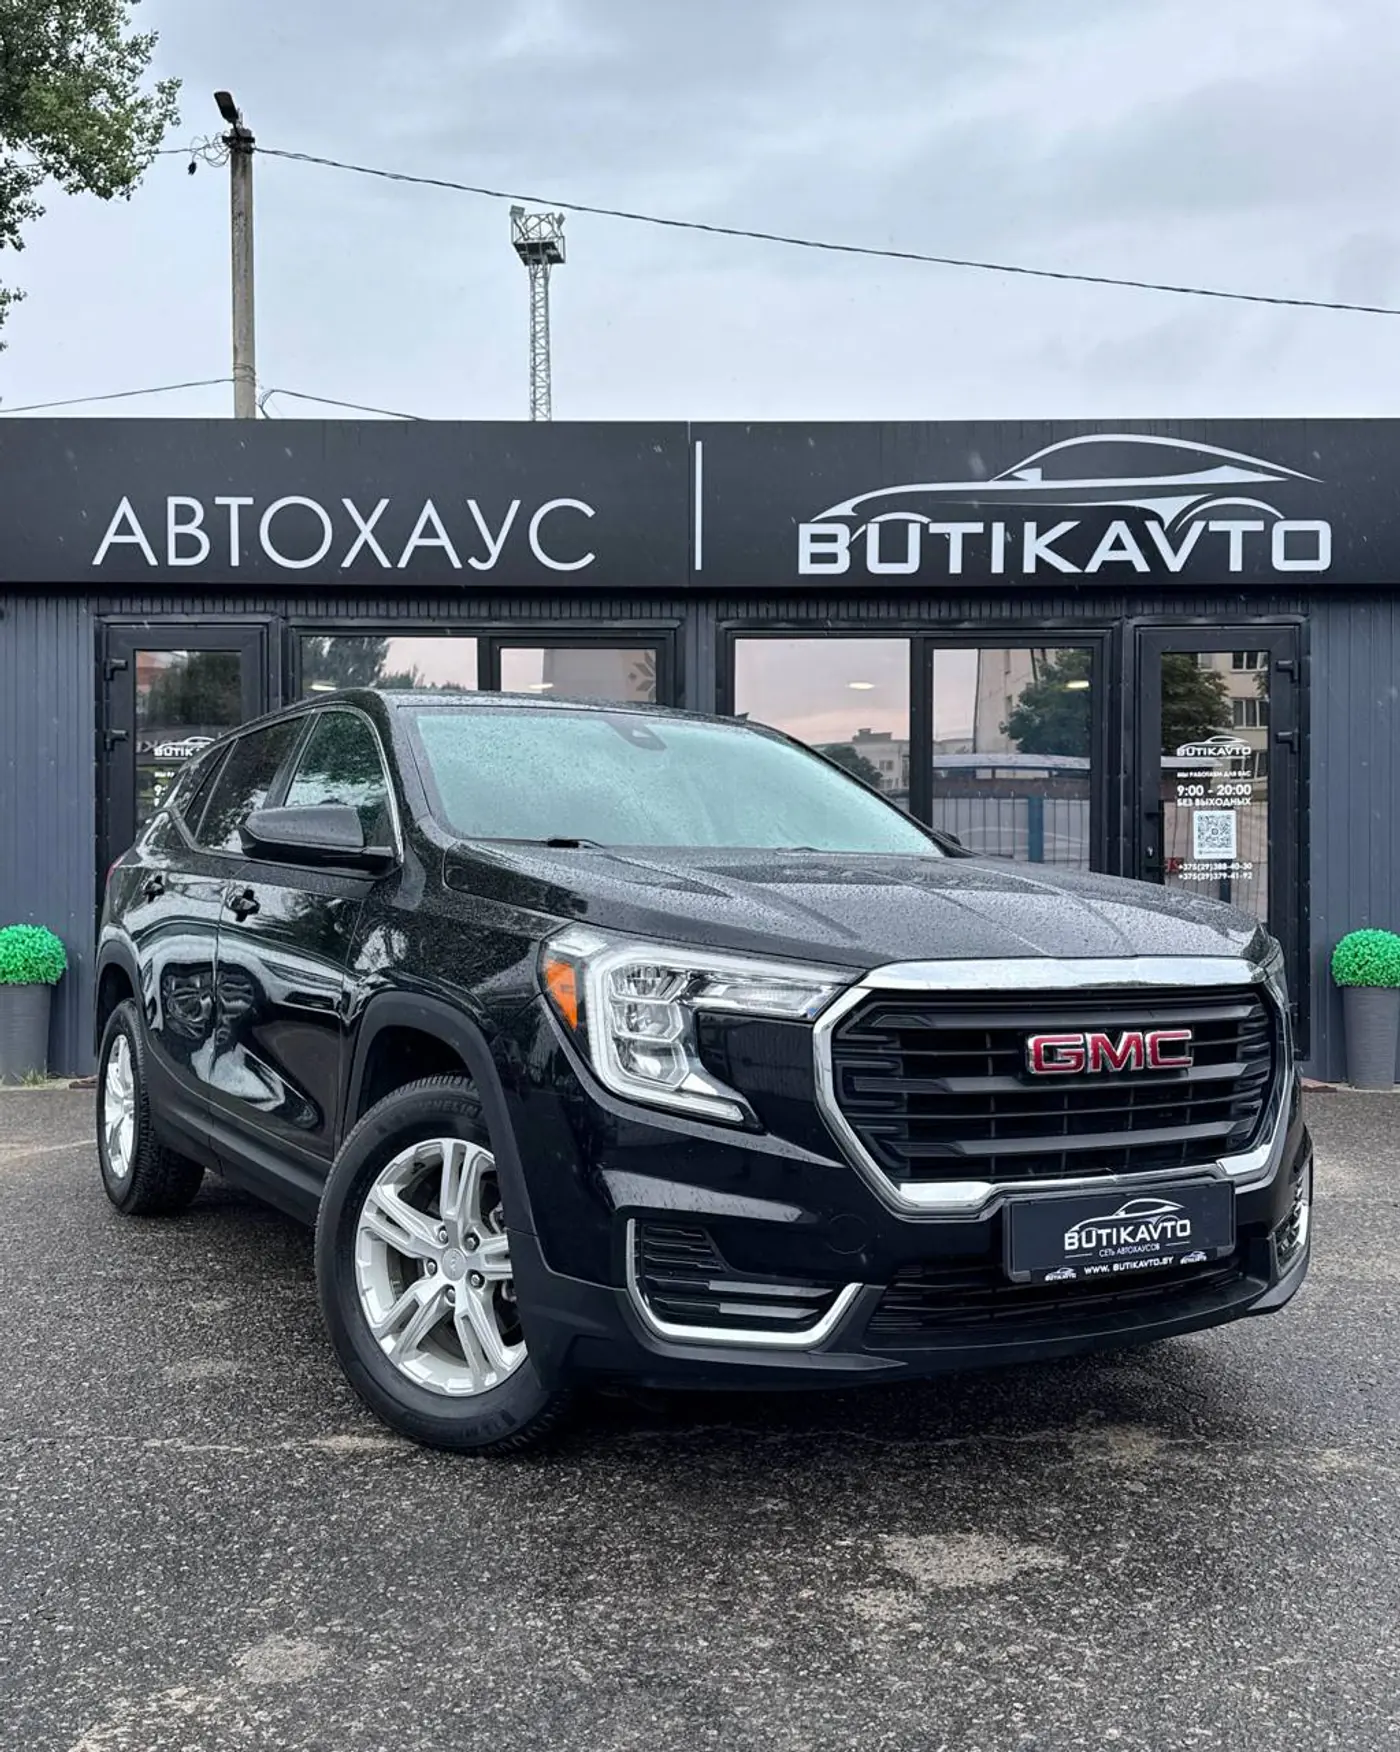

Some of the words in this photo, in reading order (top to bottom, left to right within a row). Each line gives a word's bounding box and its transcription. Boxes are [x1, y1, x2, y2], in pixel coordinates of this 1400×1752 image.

[92, 495, 596, 571] АВТОХАУС
[798, 519, 1332, 575] BUTIKAVTO
[154, 747, 199, 757] BUTIK
[1176, 746, 1252, 757] BUTIKAVTO
[1176, 784, 1204, 797] 9:00
[1216, 784, 1252, 796] 20:00
[1176, 798, 1193, 807] БЕЗ
[1195, 797, 1252, 807] ВЫХОДНЫХ
[1027, 1029, 1194, 1075] GMC
[1064, 1218, 1192, 1251] BUTIKAVTO
